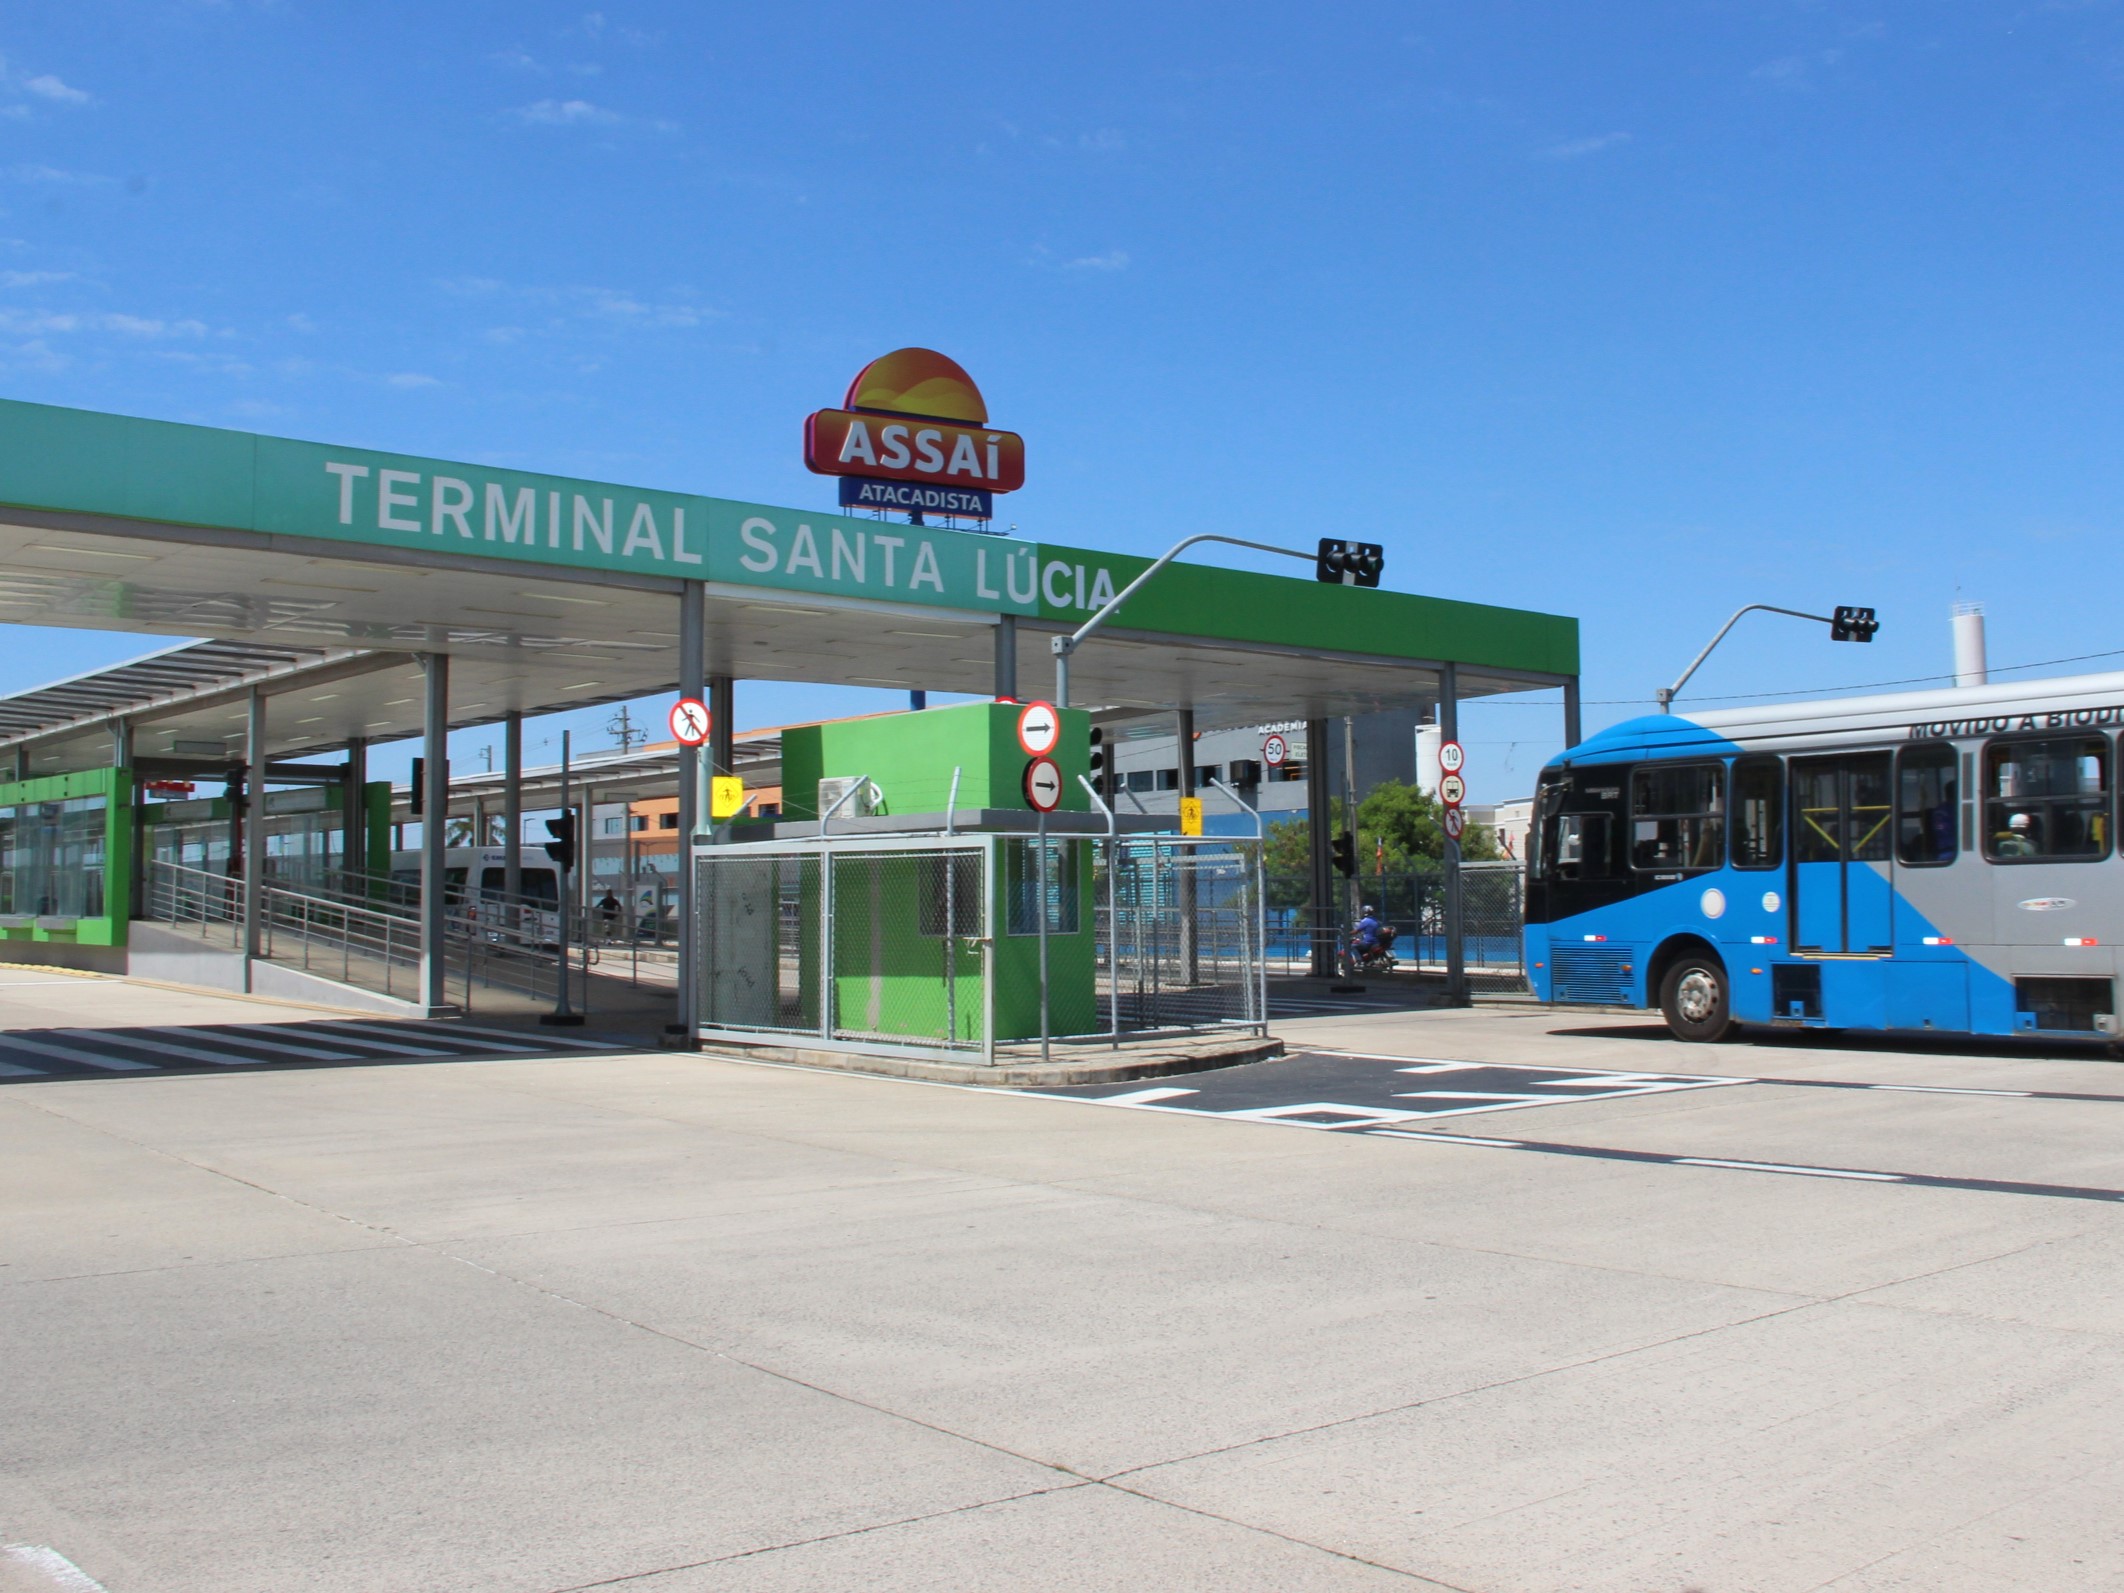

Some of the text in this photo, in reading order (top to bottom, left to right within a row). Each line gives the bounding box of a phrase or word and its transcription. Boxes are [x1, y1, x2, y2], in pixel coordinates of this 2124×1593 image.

[859, 483, 983, 512] ATACADISTA
[325, 461, 1121, 614] TERMINAL SANTA LÚCIA
[1258, 720, 1307, 734] ACADEMIA
[1909, 718, 2009, 738] MOVIDO
[2018, 714, 2037, 730] A
[1267, 743, 1282, 756] 50
[1445, 748, 1458, 761] 10
